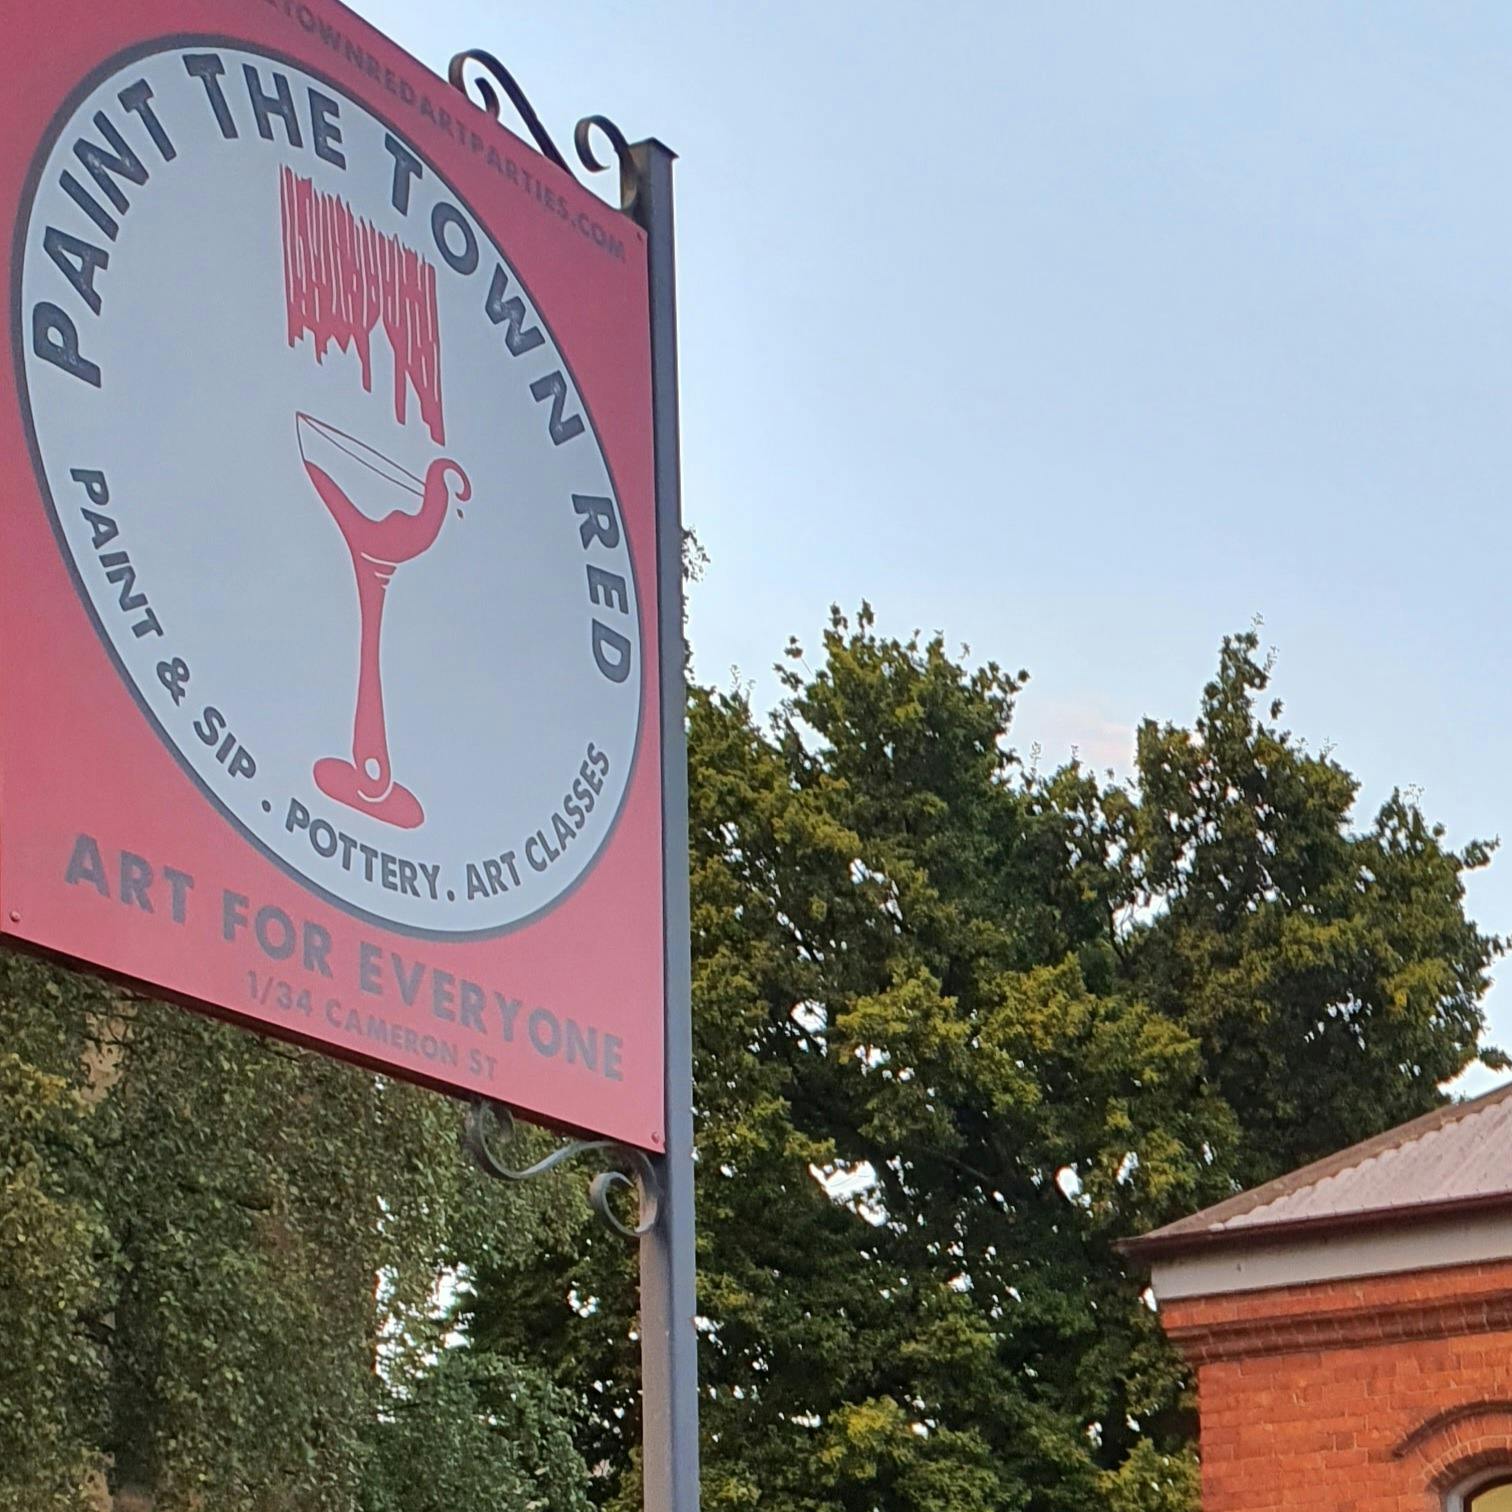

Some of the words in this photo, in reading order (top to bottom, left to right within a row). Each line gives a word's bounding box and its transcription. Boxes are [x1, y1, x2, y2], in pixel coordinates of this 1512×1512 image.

[265, 0, 627, 264] TOWNREDARTPARTIES.COM
[32, 78, 177, 389] PAINT
[182, 53, 347, 171] THE
[384, 132, 586, 447] TOWN
[571, 493, 632, 684] RED
[69, 467, 164, 638] PAINT
[156, 656, 190, 707] &
[192, 706, 256, 780] SIP
[466, 850, 521, 901] ART
[524, 741, 610, 873] CLASSES
[64, 832, 194, 925] ART
[222, 888, 333, 979] FOR
[359, 940, 624, 1082] EVERYONE
[246, 969, 314, 1018] 1/34
[324, 999, 460, 1068] CAMERON
[469, 1048, 499, 1082] ST
